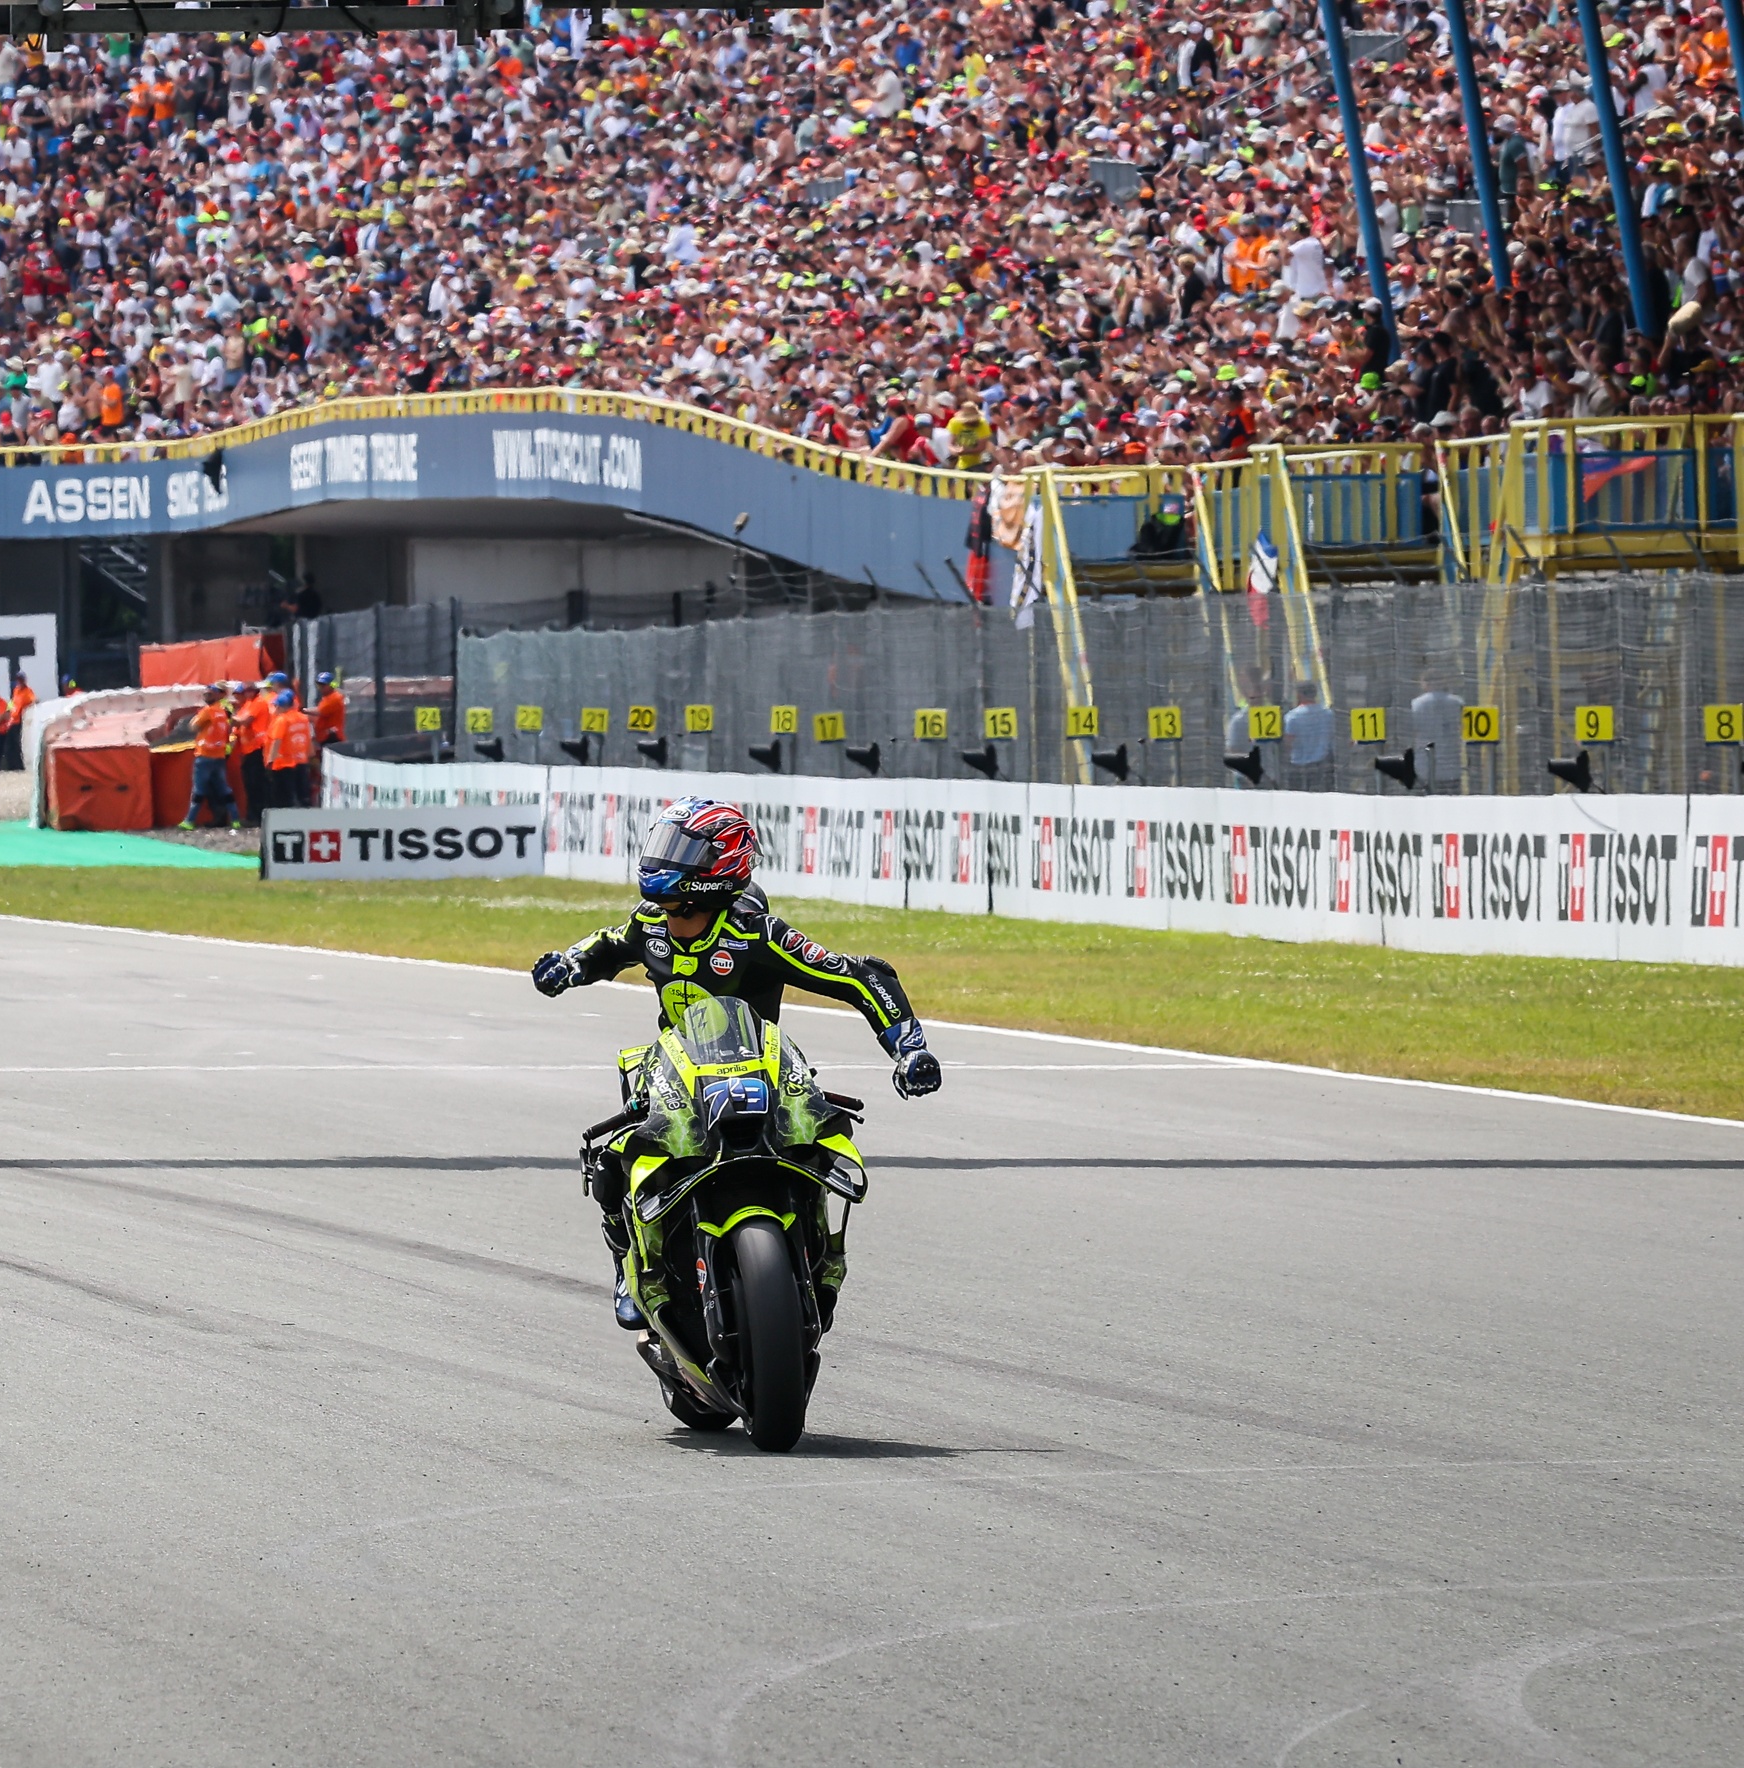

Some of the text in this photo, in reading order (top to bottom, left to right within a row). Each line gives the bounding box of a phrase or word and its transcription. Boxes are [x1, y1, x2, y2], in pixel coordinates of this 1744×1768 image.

[22, 476, 149, 524] ASSEN
[420, 708, 440, 727] 24
[471, 710, 490, 728] 23
[520, 708, 539, 728] 22
[587, 710, 606, 729] 21
[631, 708, 654, 728] 20
[688, 708, 710, 729] 19
[775, 710, 793, 731] 18
[818, 716, 839, 737] 17
[920, 713, 943, 736] 16
[989, 712, 1012, 735] 15
[1072, 711, 1095, 734] 14
[1152, 711, 1177, 737] 13
[1253, 710, 1277, 736] 12
[1358, 712, 1380, 737] 11
[1464, 710, 1491, 738] 10
[1585, 710, 1600, 738] 9
[1716, 710, 1734, 740] 8
[349, 825, 536, 862] TISSOT
[1055, 817, 1115, 896] TISSOT
[1148, 821, 1214, 901] TISSOT
[1250, 825, 1321, 909] TISSOT
[690, 880, 733, 893] SuperFile
[1353, 830, 1423, 918] TISSOT
[1463, 832, 1547, 921] TISSOT
[1589, 833, 1678, 926] TISSOT
[650, 941, 668, 954] Arai
[711, 957, 733, 969] Gulf
[867, 974, 897, 1010] SuperFile
[716, 1064, 748, 1076] aprilia
[650, 1064, 681, 1111] SuperFile
